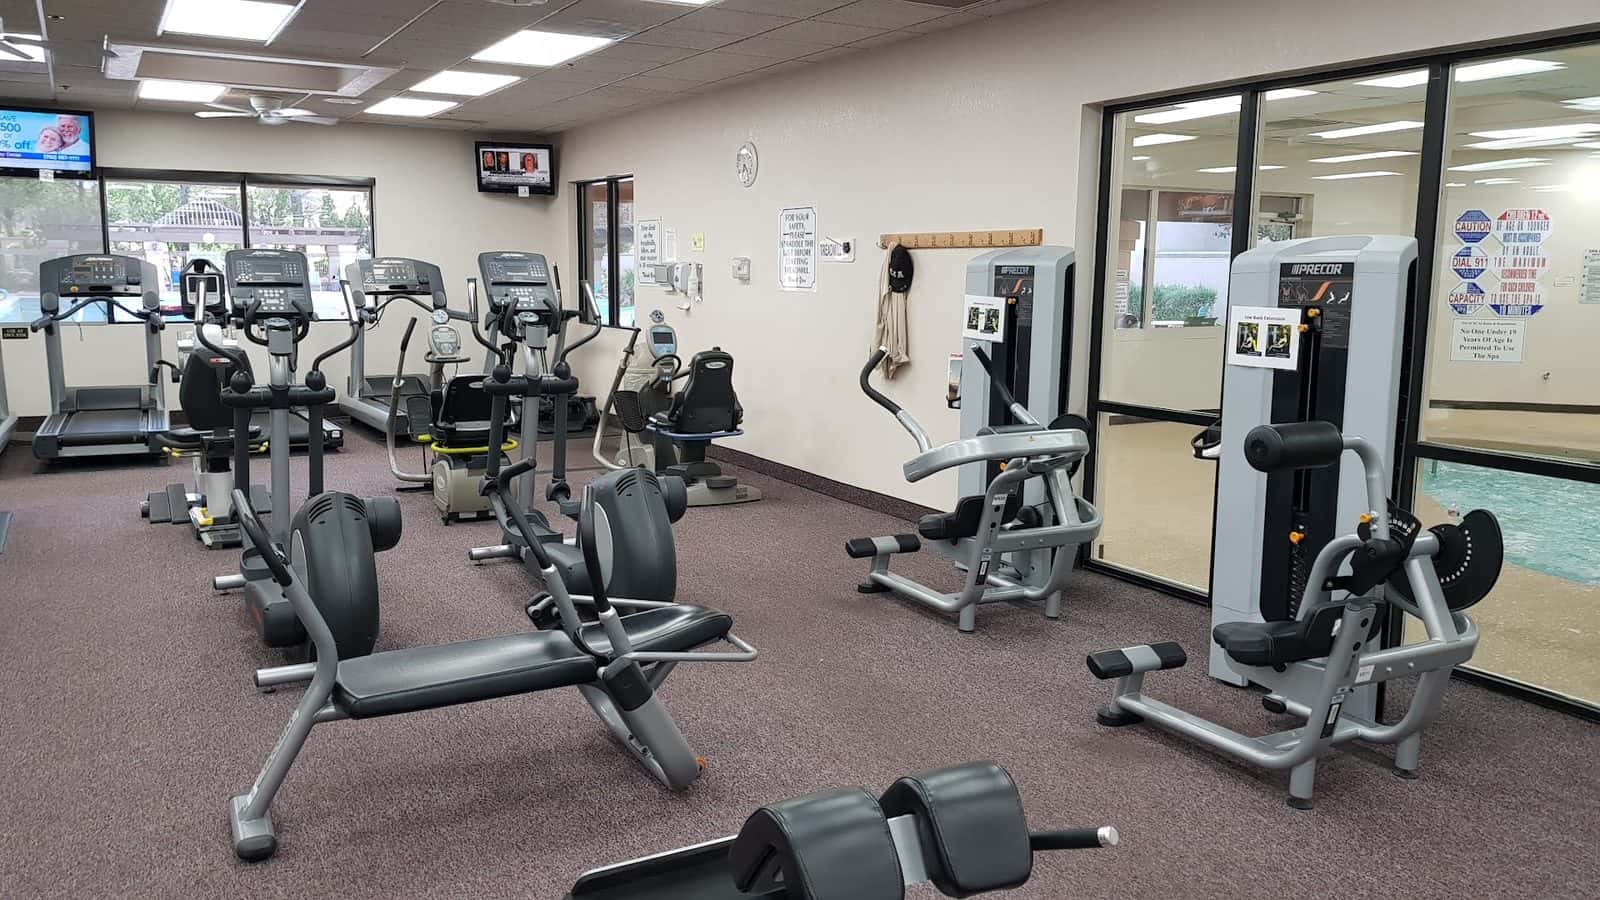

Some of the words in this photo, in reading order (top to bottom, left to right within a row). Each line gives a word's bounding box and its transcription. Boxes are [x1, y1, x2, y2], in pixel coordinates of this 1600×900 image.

[1455, 222, 1491, 231] CAUTION
[1453, 257, 1471, 267] DIAL
[1474, 257, 1488, 268] 911
[1299, 264, 1343, 275] PRECOR
[1449, 293, 1485, 304] CAPACITY
